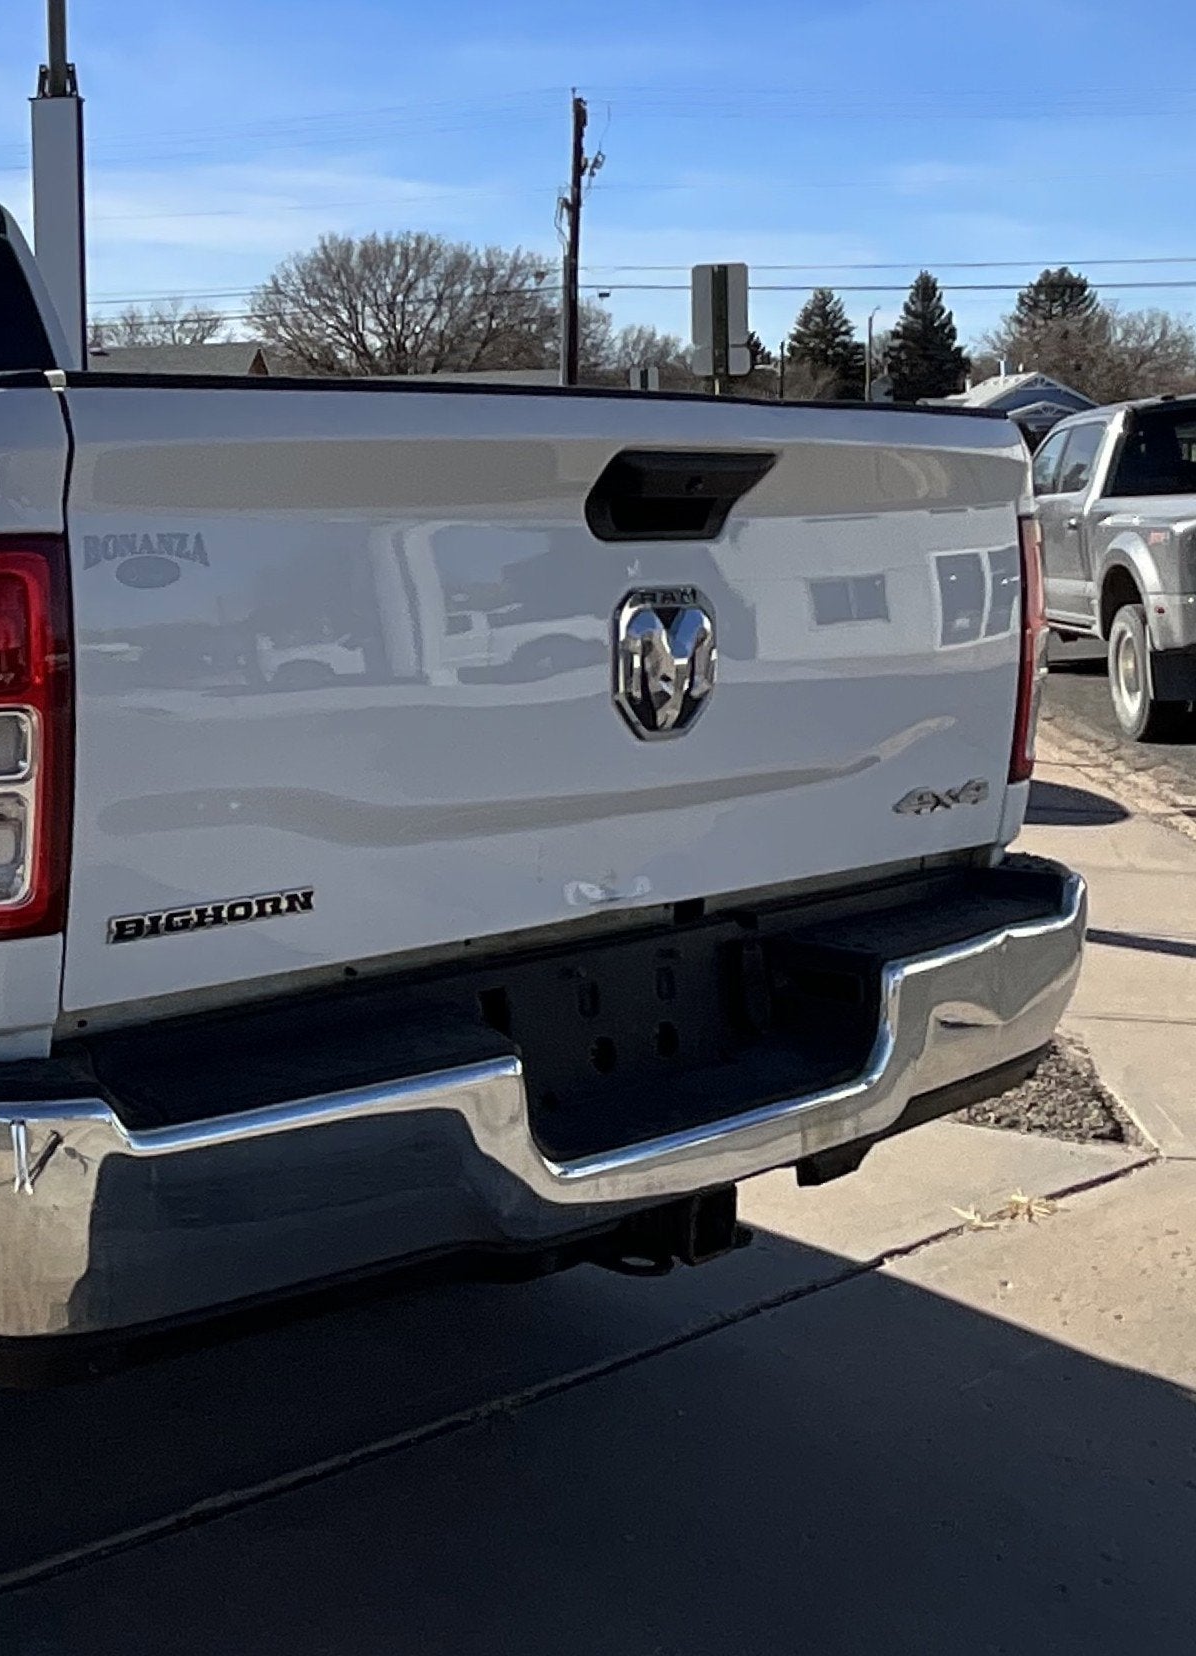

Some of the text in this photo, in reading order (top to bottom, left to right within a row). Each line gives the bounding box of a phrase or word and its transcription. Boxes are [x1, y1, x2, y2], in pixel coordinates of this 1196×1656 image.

[82, 532, 211, 571] BONANZA
[640, 586, 698, 604] RAM
[106, 886, 314, 943] BIGHORN
